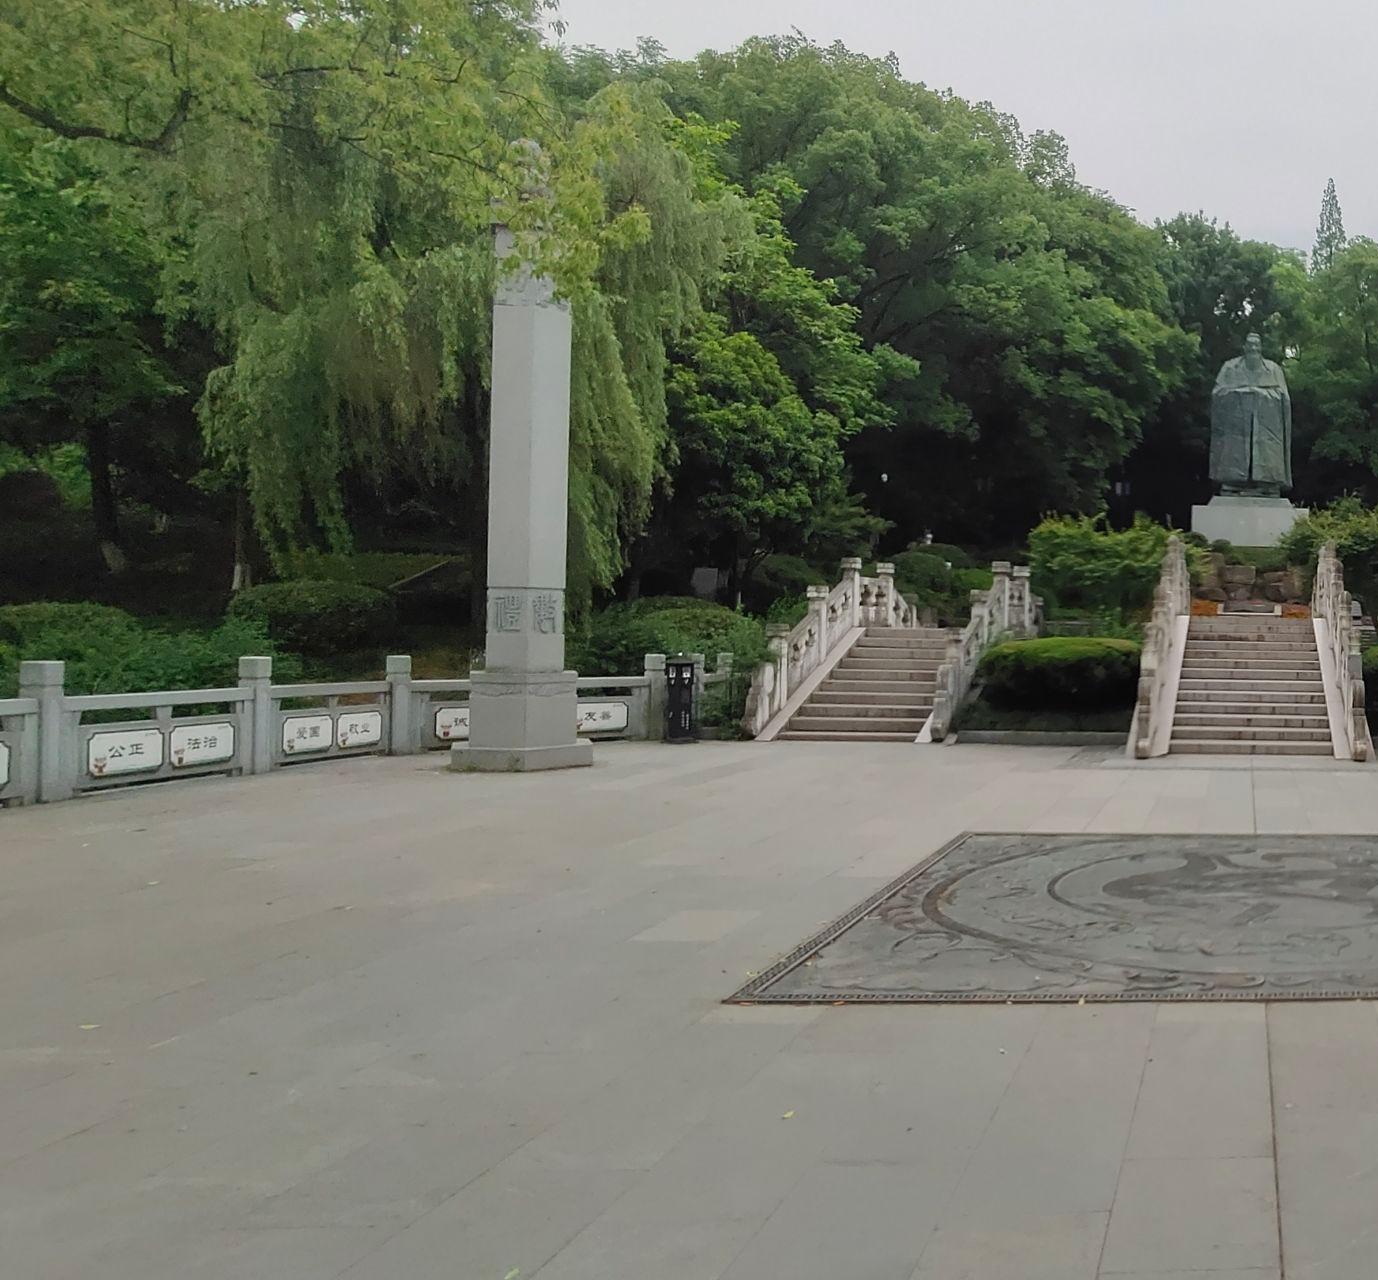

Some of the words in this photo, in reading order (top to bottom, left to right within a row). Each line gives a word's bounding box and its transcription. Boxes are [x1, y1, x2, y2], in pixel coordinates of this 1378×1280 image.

[584, 711, 612, 722] 友善
[296, 725, 321, 740] 爱国
[187, 736, 218, 750] 法治
[108, 743, 145, 759] 公正
